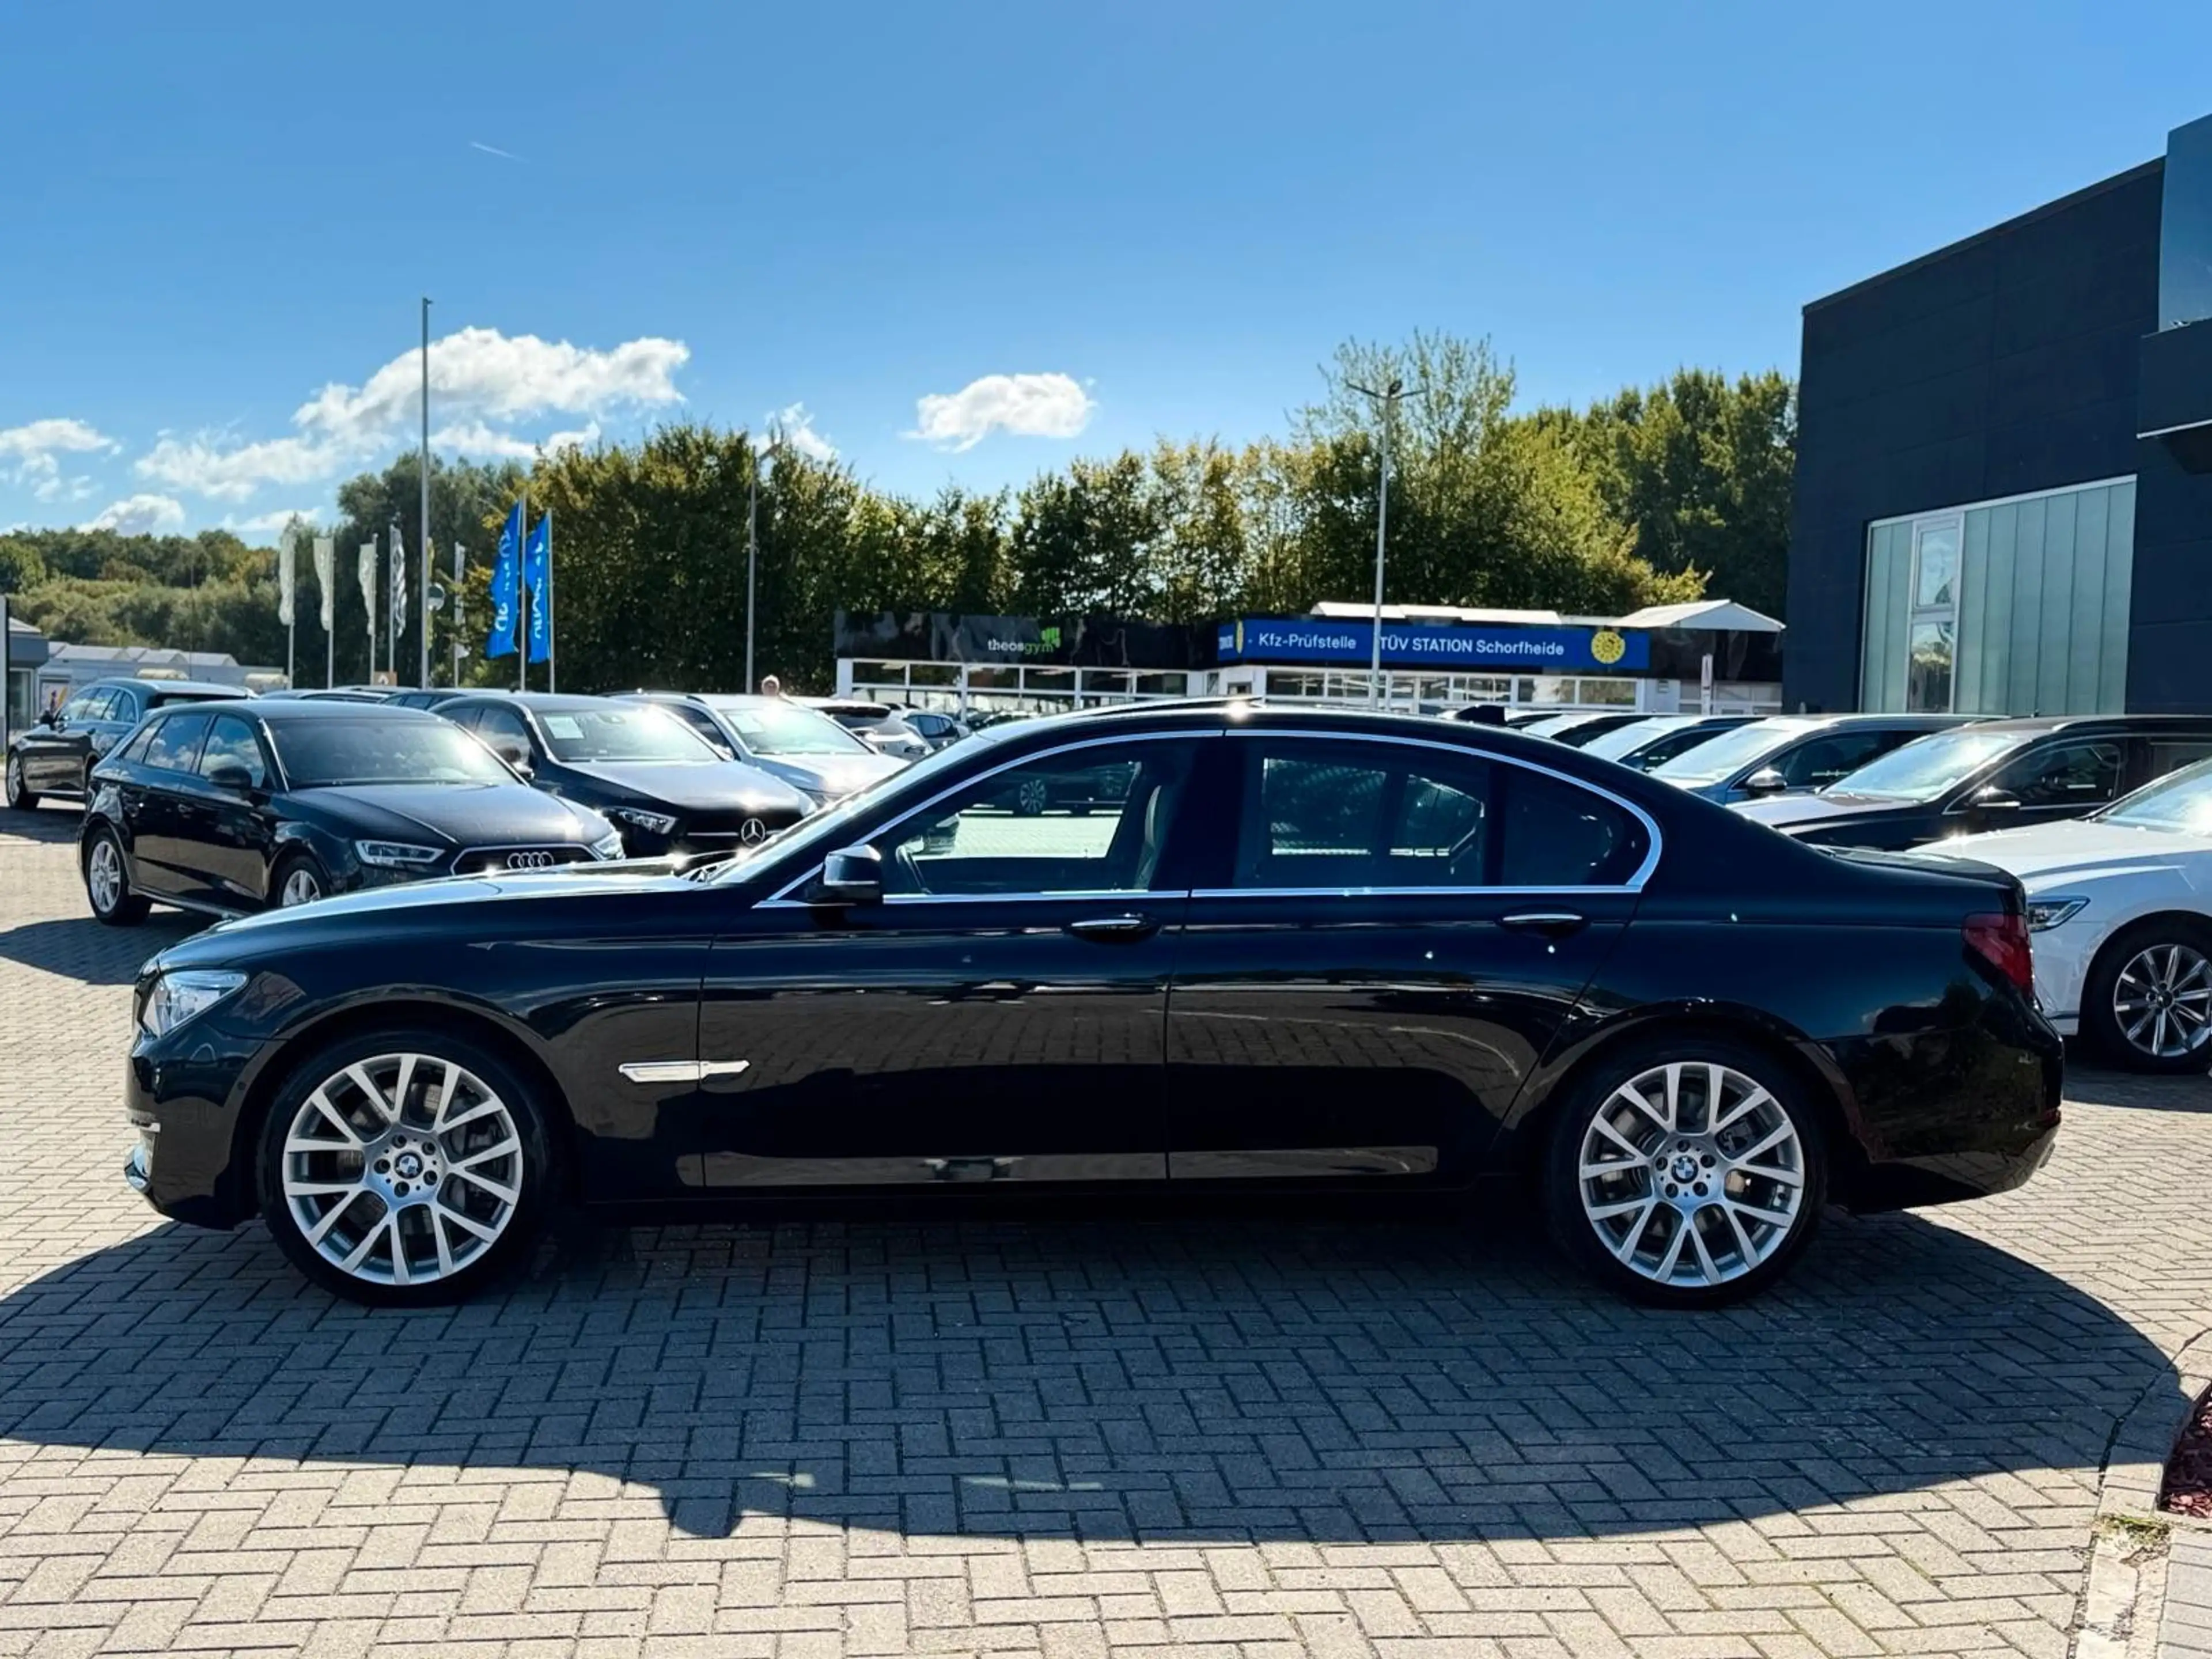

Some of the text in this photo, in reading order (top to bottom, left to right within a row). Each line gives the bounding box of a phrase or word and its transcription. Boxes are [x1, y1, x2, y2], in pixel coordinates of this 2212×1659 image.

[1259, 632, 1565, 656] Kfz-Prüfstelle TÜV STATION Schorfheide
